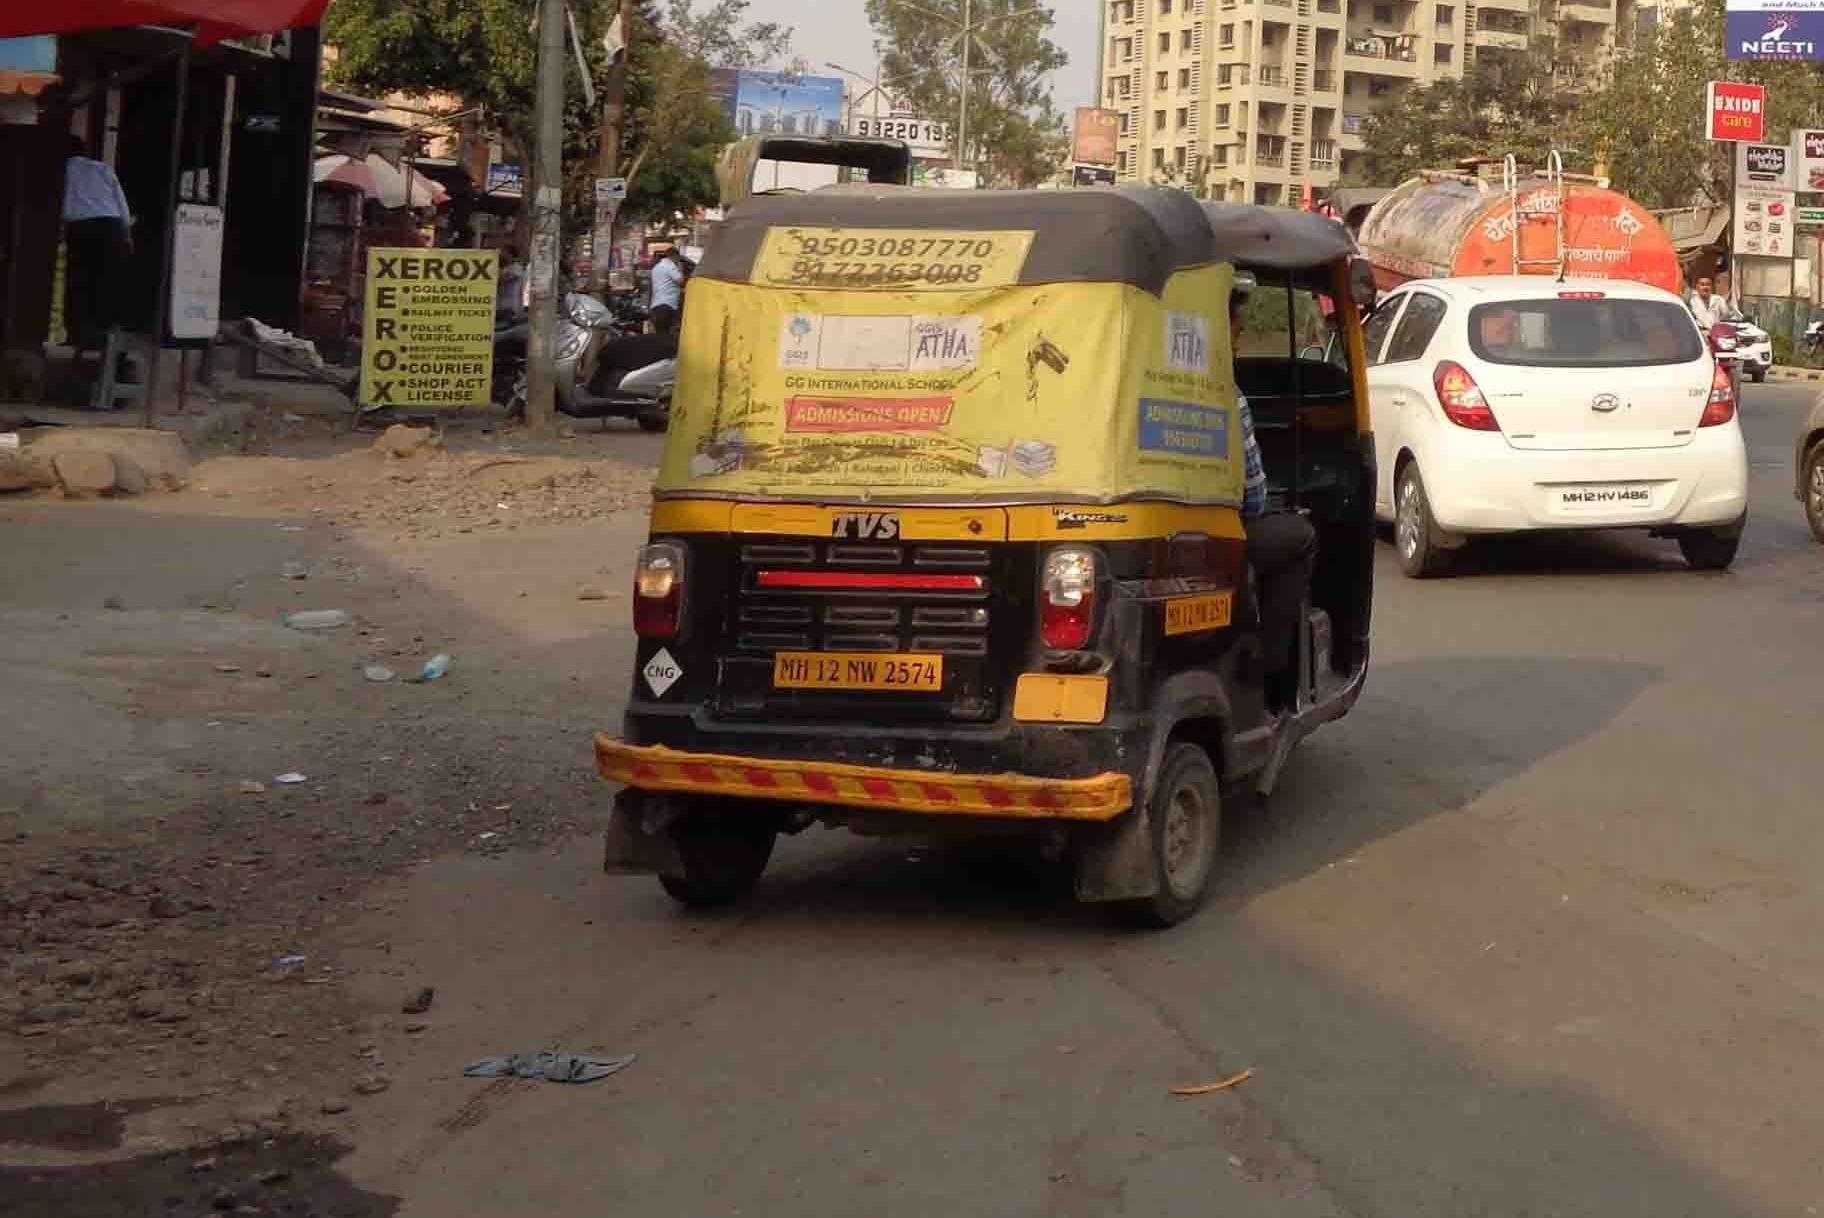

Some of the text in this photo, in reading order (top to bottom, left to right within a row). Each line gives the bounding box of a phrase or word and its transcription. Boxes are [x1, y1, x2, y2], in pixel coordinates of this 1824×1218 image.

[1785, 0, 1816, 8] Much
[1742, 41, 1814, 54] NEETI
[1715, 95, 1760, 113] EXIDE
[802, 237, 992, 258] 9503087770
[376, 258, 493, 280] XEROX
[412, 296, 490, 304] EMBOSSING
[410, 324, 453, 332] POLICE
[410, 334, 492, 342] VERIFICATION
[409, 363, 483, 374] COURIER
[408, 378, 486, 389] SHOP ACT
[785, 377, 957, 390] GG INTERNATIONAL SCHOOL
[408, 391, 473, 401] LICENSE
[798, 407, 893, 422] ADMISSIONS
[1563, 491, 1649, 503] MH 12 HV 1486
[832, 514, 899, 538] TVS
[647, 666, 675, 679] CNG
[779, 659, 937, 685] MH 12 NW 2574
